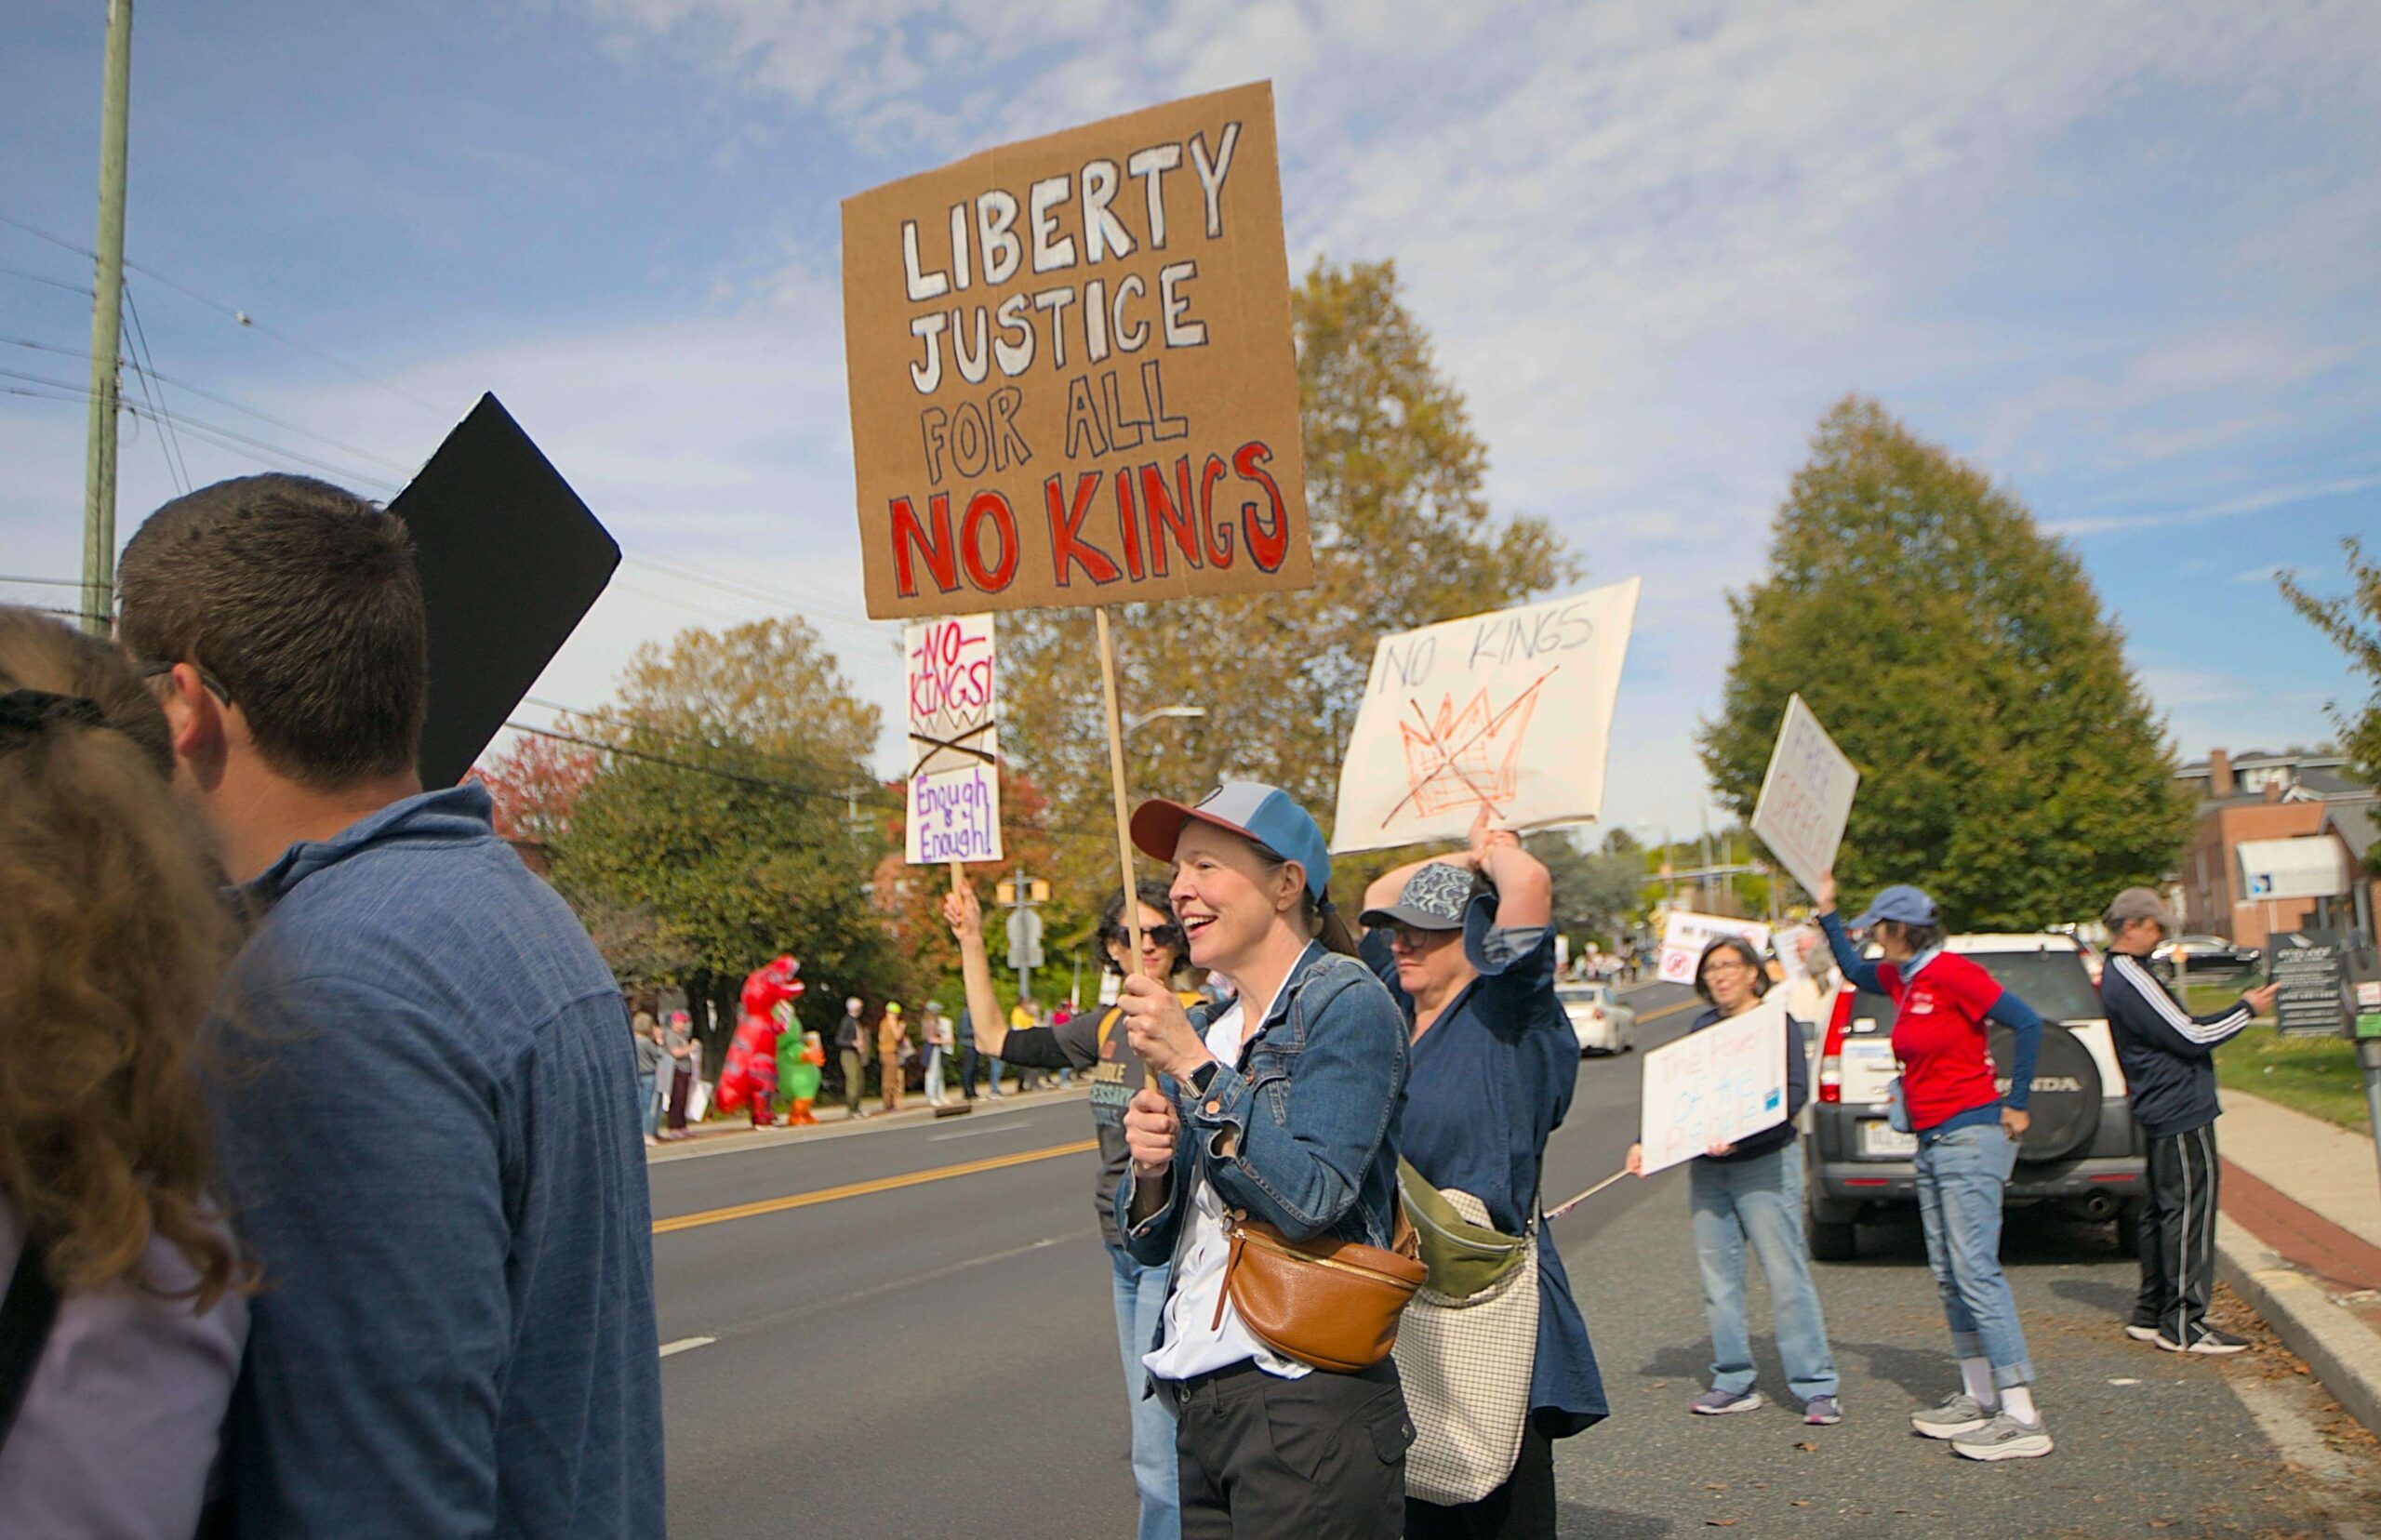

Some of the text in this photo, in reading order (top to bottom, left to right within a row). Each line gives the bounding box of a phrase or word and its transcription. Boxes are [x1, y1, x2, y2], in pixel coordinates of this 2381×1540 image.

[902, 122, 1243, 302] LIBERTY
[911, 261, 1208, 394] JUSTICE
[922, 360, 1189, 485] FOR ALL
[889, 441, 1289, 597] NO KINGS
[1379, 602, 1594, 695] NO KINGS
[916, 768, 989, 818] Enough
